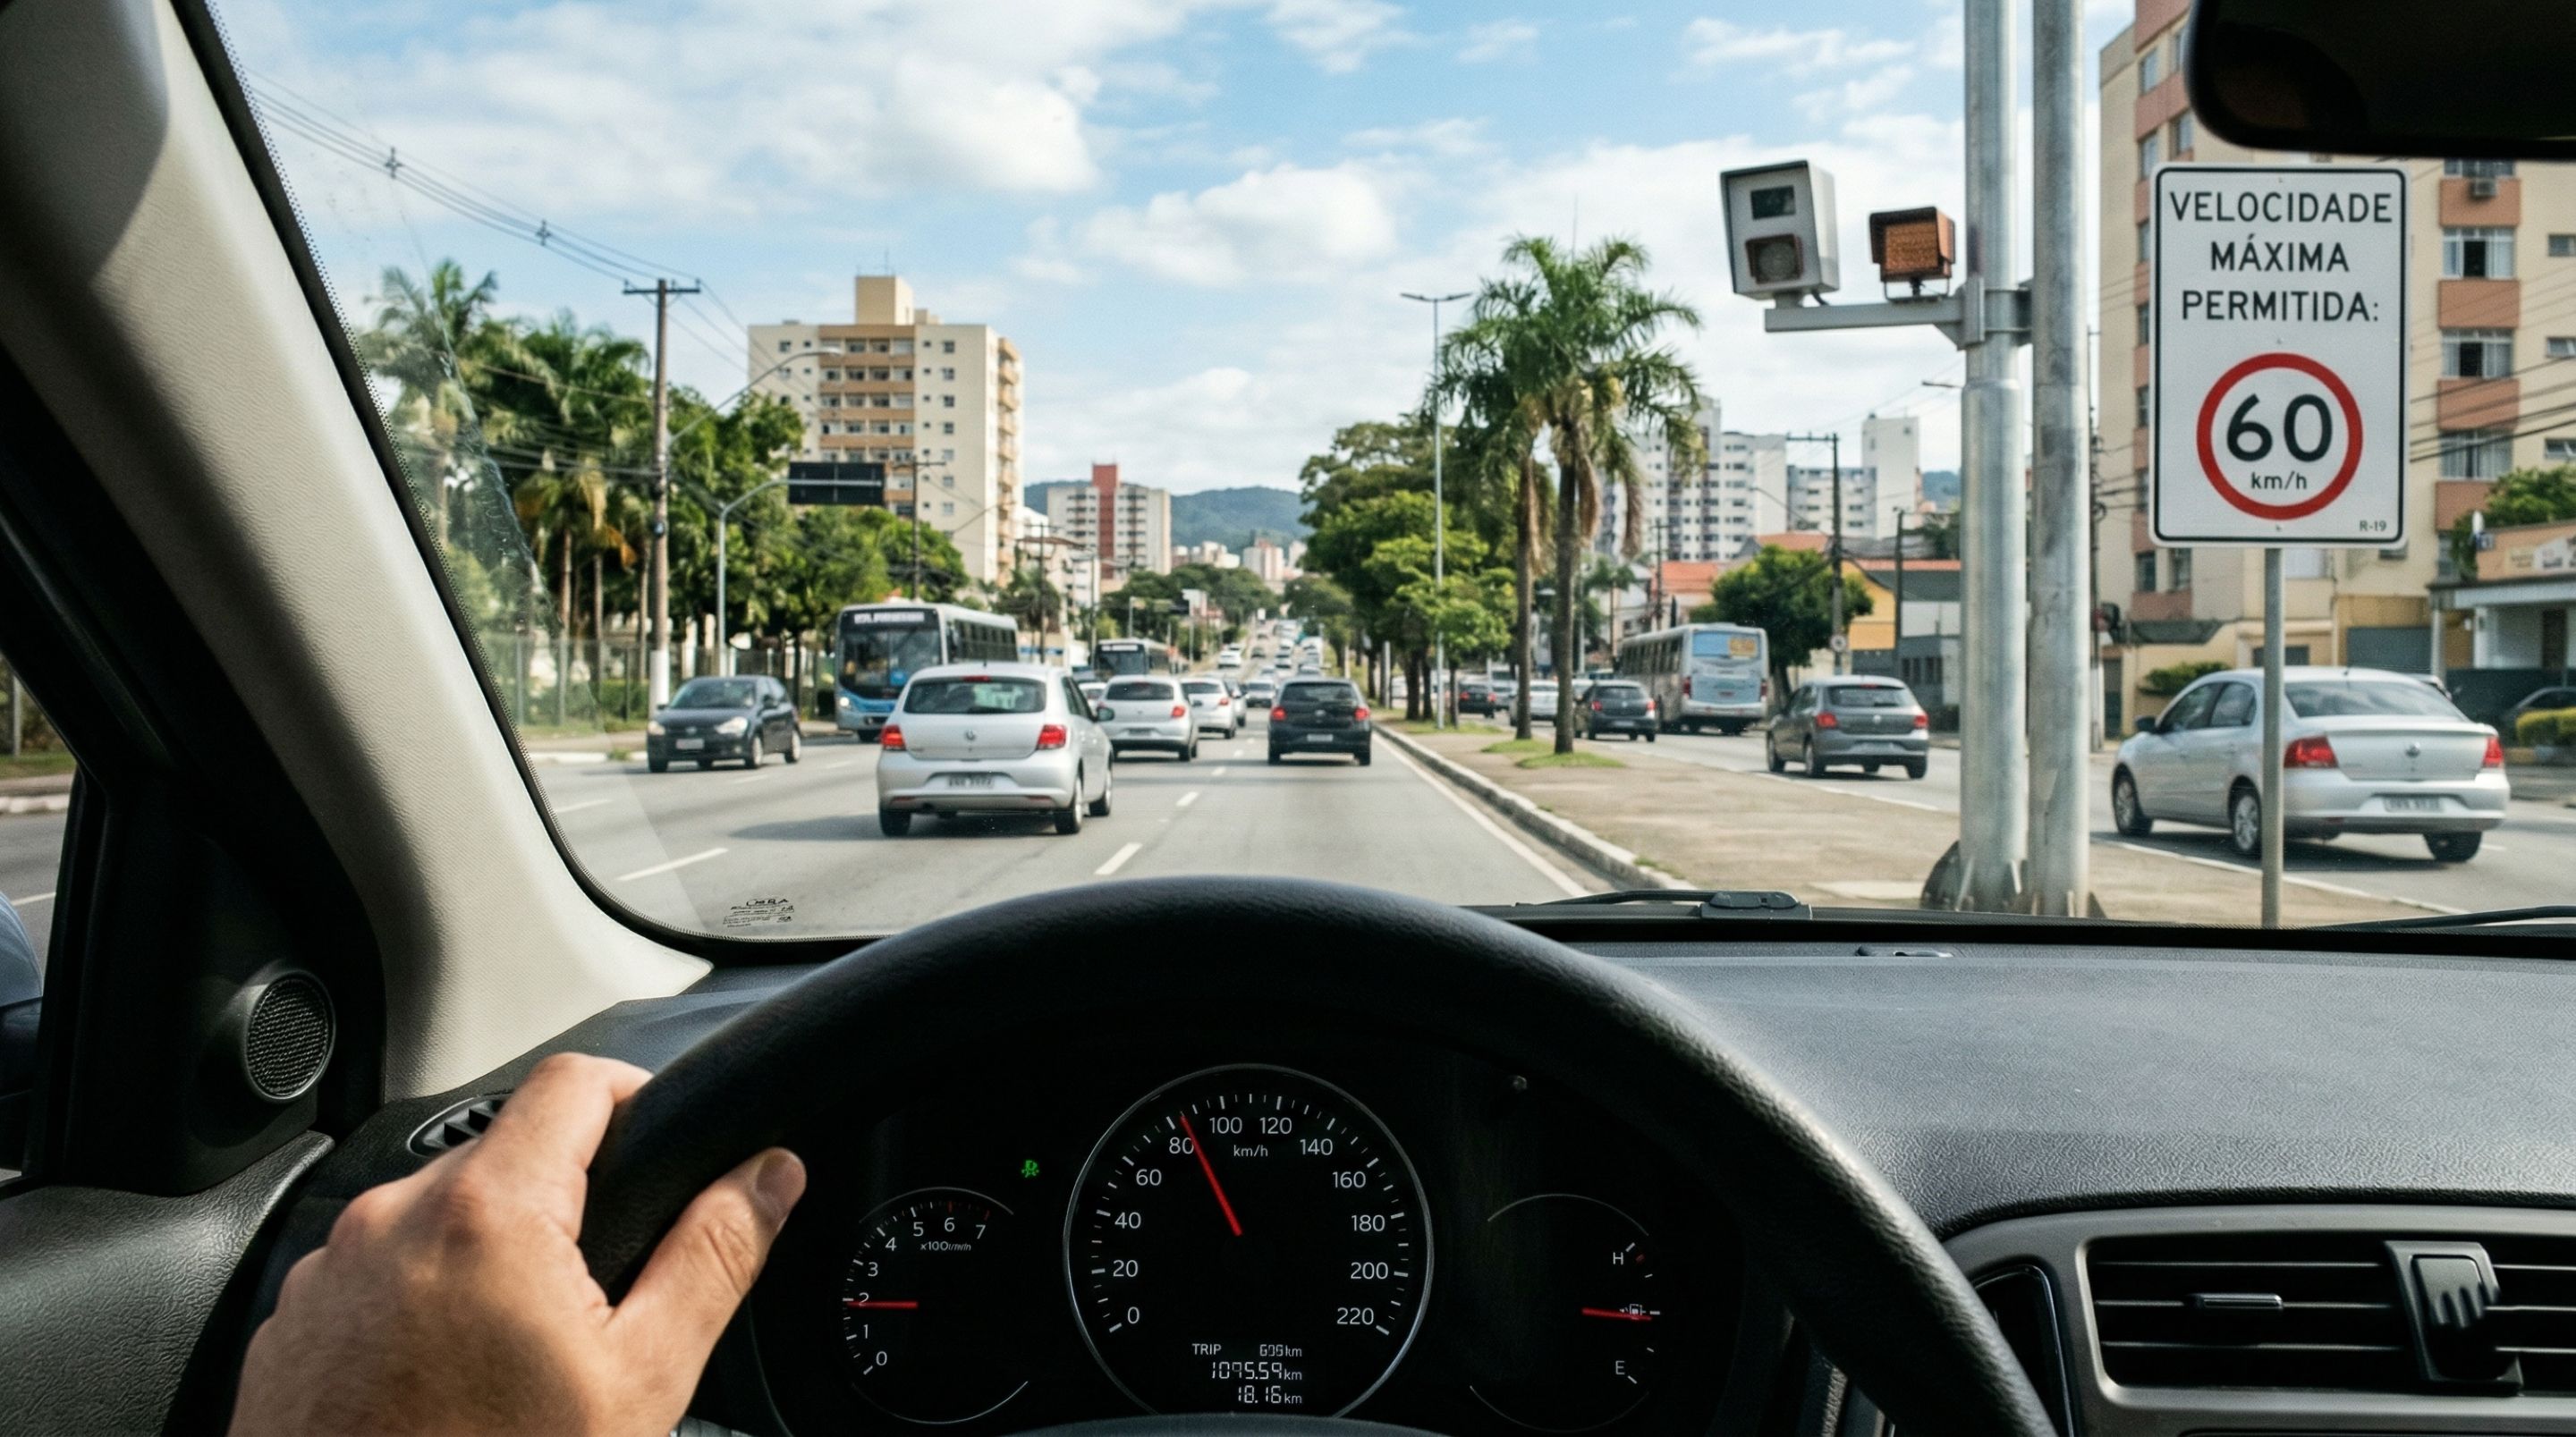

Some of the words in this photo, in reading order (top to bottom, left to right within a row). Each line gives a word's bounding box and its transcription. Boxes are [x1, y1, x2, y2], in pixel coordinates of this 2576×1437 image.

[2169, 190, 2393, 224] VELOCIDADE
[2210, 232, 2350, 273] MÁXIMA
[2182, 290, 2378, 322] PERMITIDA:
[2226, 393, 2333, 463] 60
[2250, 470, 2308, 491] km/h
[2359, 520, 2387, 533] R-19
[1209, 1116, 1243, 1135] 100
[1259, 1116, 1293, 1135] 120
[1168, 1137, 1195, 1155] 80
[1233, 1144, 1268, 1158] km/h
[1300, 1137, 1334, 1156] 140
[1135, 1168, 1162, 1187] 60
[1332, 1171, 1367, 1188] 160
[912, 1221, 924, 1237] 5
[944, 1217, 955, 1232] 6
[1114, 1211, 1141, 1230] 40
[1351, 1214, 1385, 1233] 180
[975, 1224, 987, 1239] 7
[885, 1237, 897, 1252] 4
[1613, 1251, 1624, 1265] H
[867, 1261, 878, 1277] 3
[1113, 1259, 1139, 1278] 20
[1350, 1262, 1389, 1280] 200
[858, 1292, 869, 1306] 2
[1127, 1306, 1140, 1324] 0
[1336, 1307, 1375, 1325] 220
[863, 1323, 869, 1339] 1
[876, 1350, 888, 1365] 0
[1191, 1343, 1222, 1356] TRIP
[1614, 1360, 1625, 1375] E
